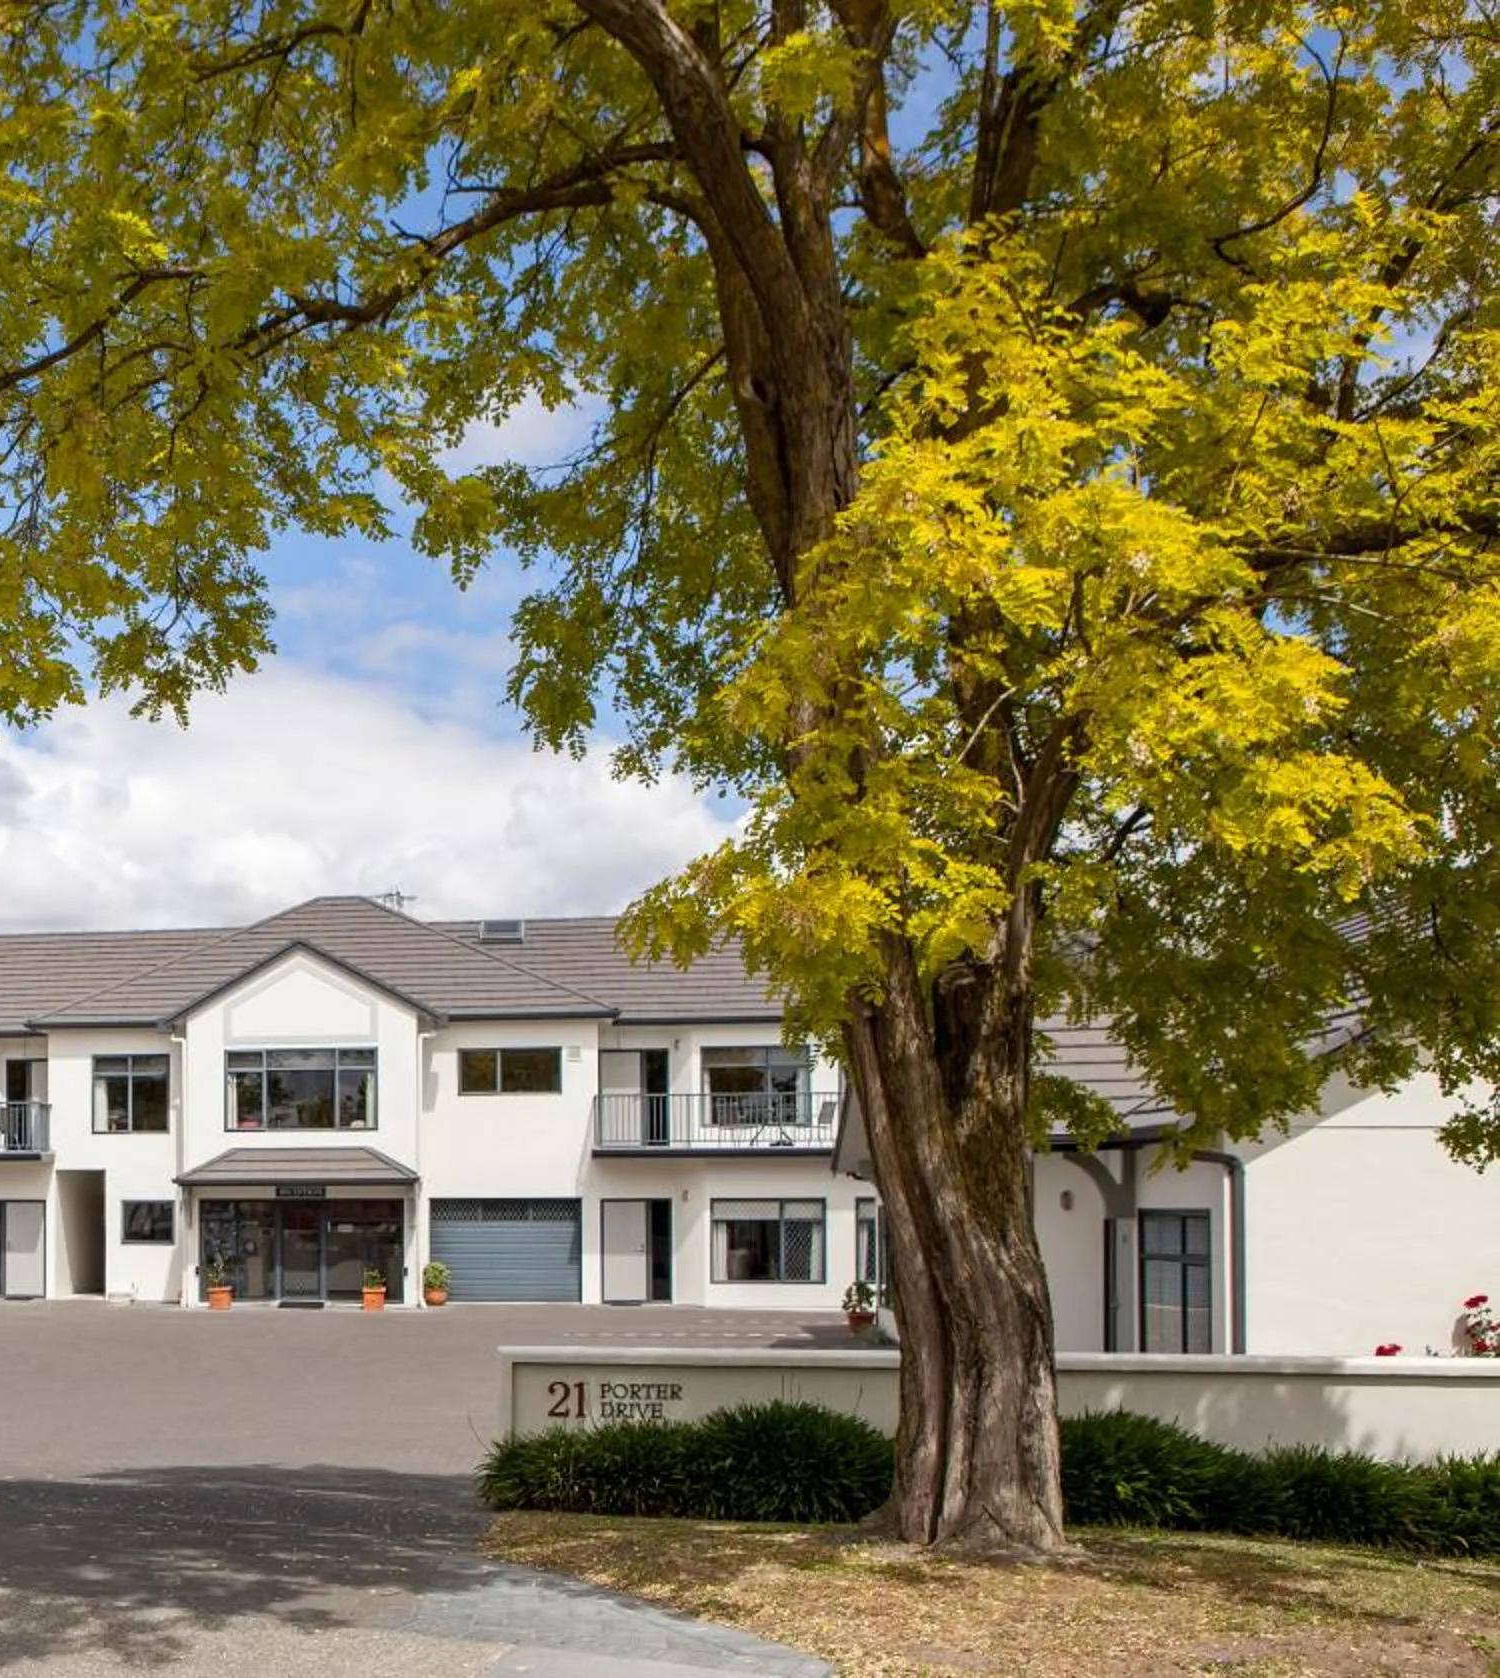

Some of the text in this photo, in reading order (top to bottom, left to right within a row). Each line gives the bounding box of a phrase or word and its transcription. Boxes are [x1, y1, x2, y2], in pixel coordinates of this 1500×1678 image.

[547, 1381, 683, 1419] 21 PORTER
[600, 1402, 663, 1419] DRIVE
